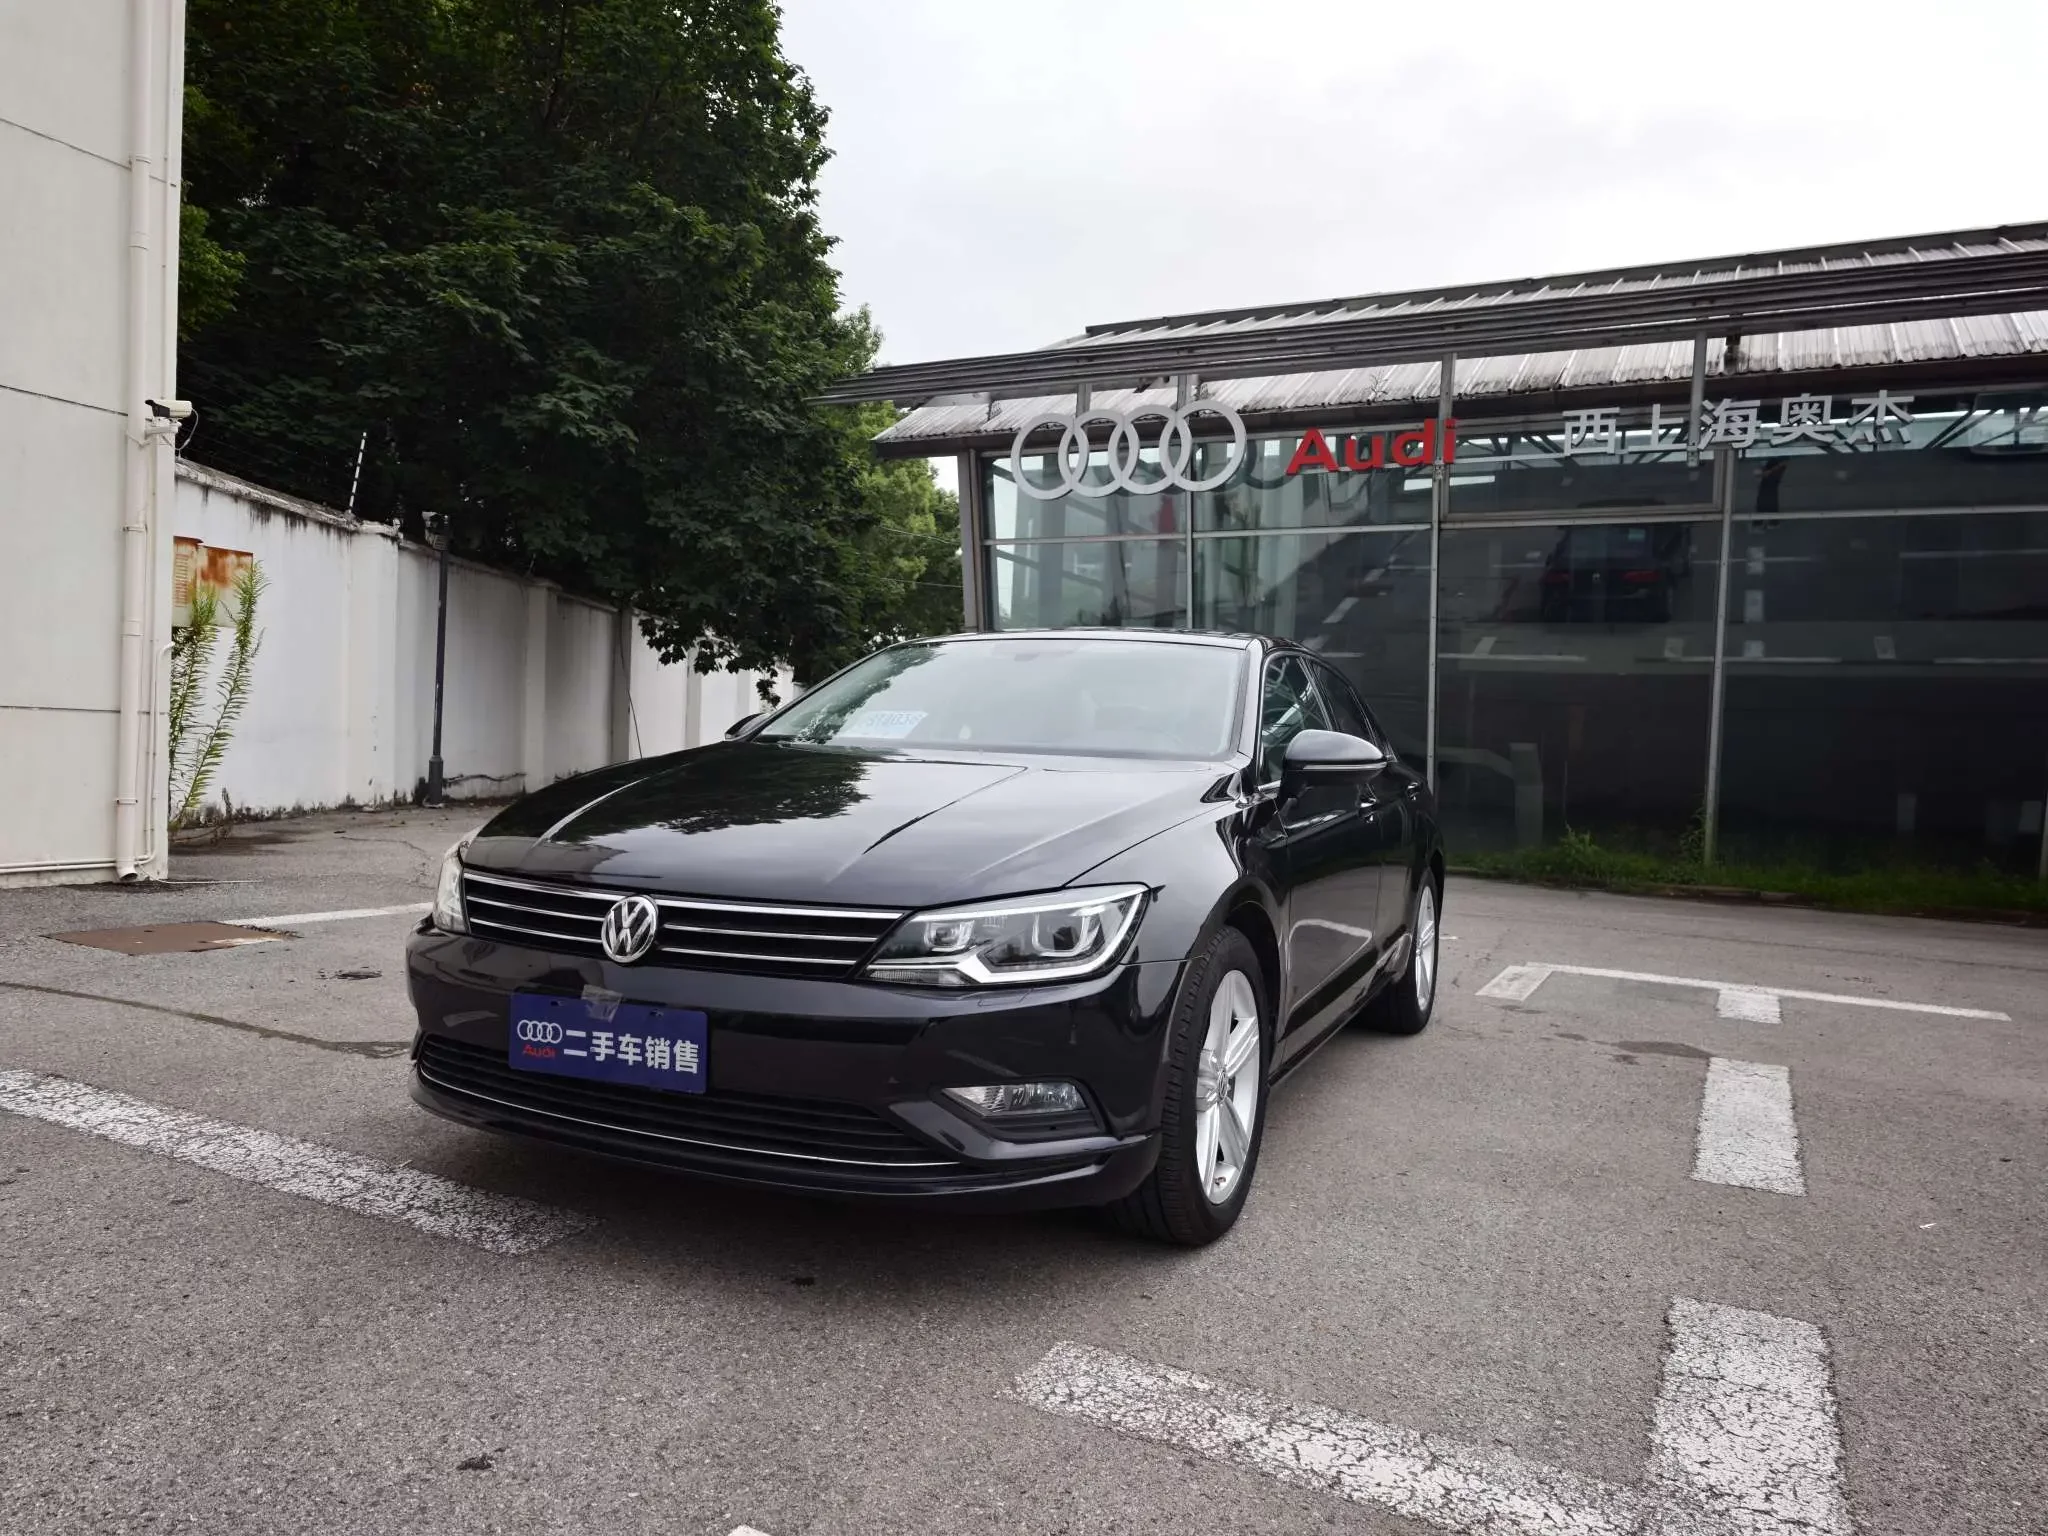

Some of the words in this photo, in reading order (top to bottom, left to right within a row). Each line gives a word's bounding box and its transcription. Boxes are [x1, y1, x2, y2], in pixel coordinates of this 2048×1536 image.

[1286, 418, 1457, 475] Audi
[1562, 389, 1915, 457] 西上海奥杰
[522, 1043, 557, 1060] Audi
[563, 1029, 699, 1074] 二手车销售
